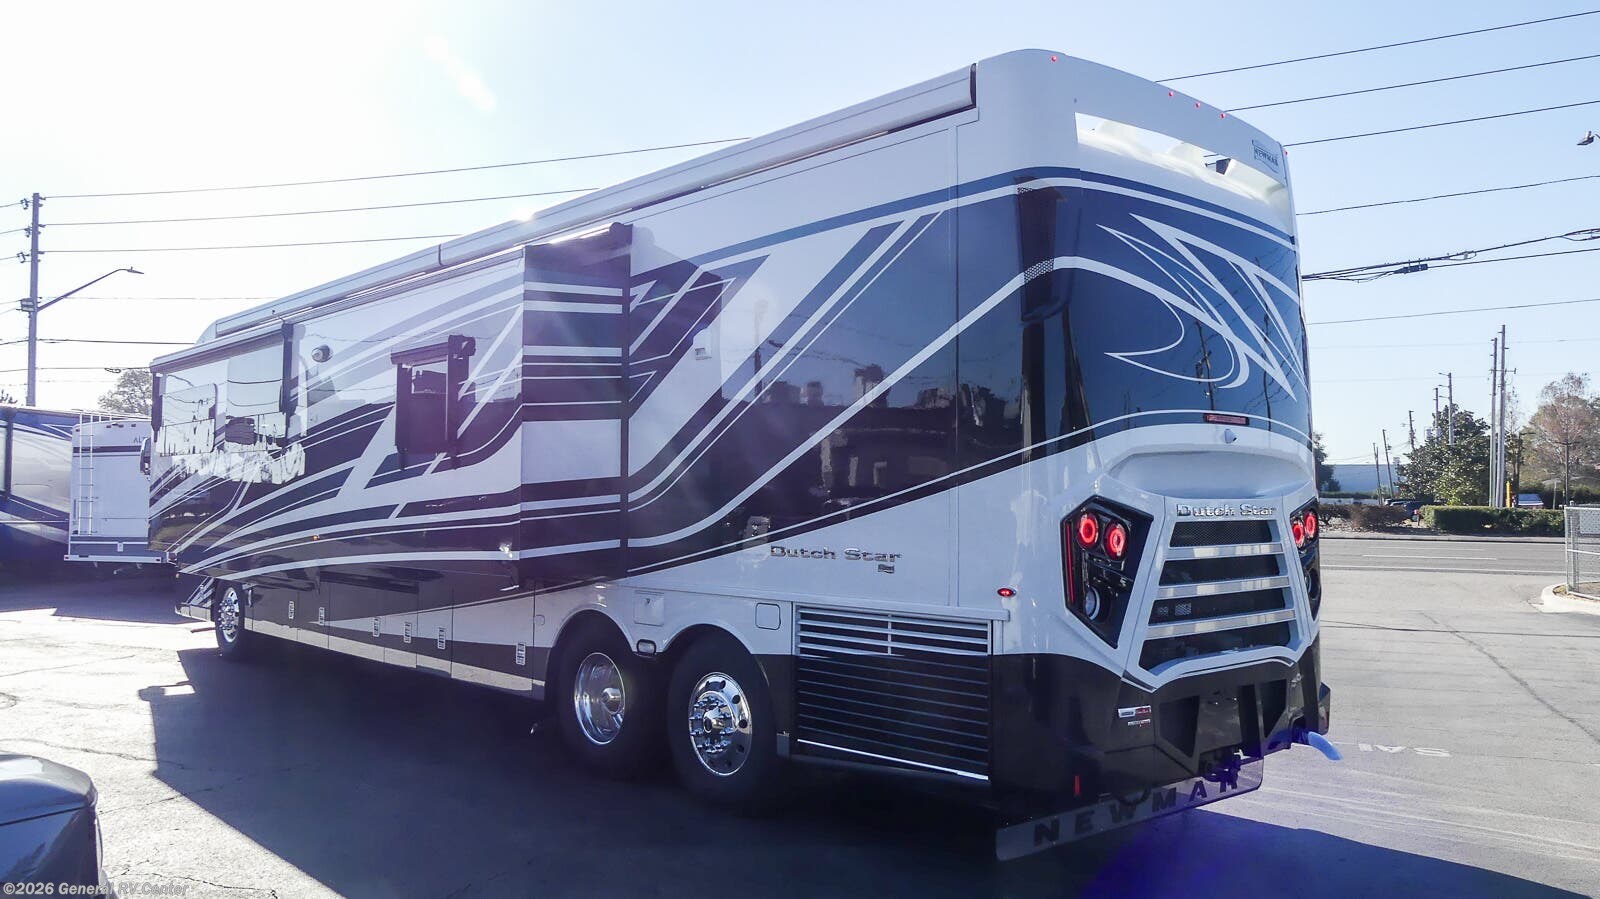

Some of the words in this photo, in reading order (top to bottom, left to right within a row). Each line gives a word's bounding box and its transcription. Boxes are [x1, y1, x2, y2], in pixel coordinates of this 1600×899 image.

[1177, 504, 1235, 517] Dutch
[1239, 503, 1276, 516] Star
[770, 545, 836, 560] Dutch
[843, 547, 902, 563] Star
